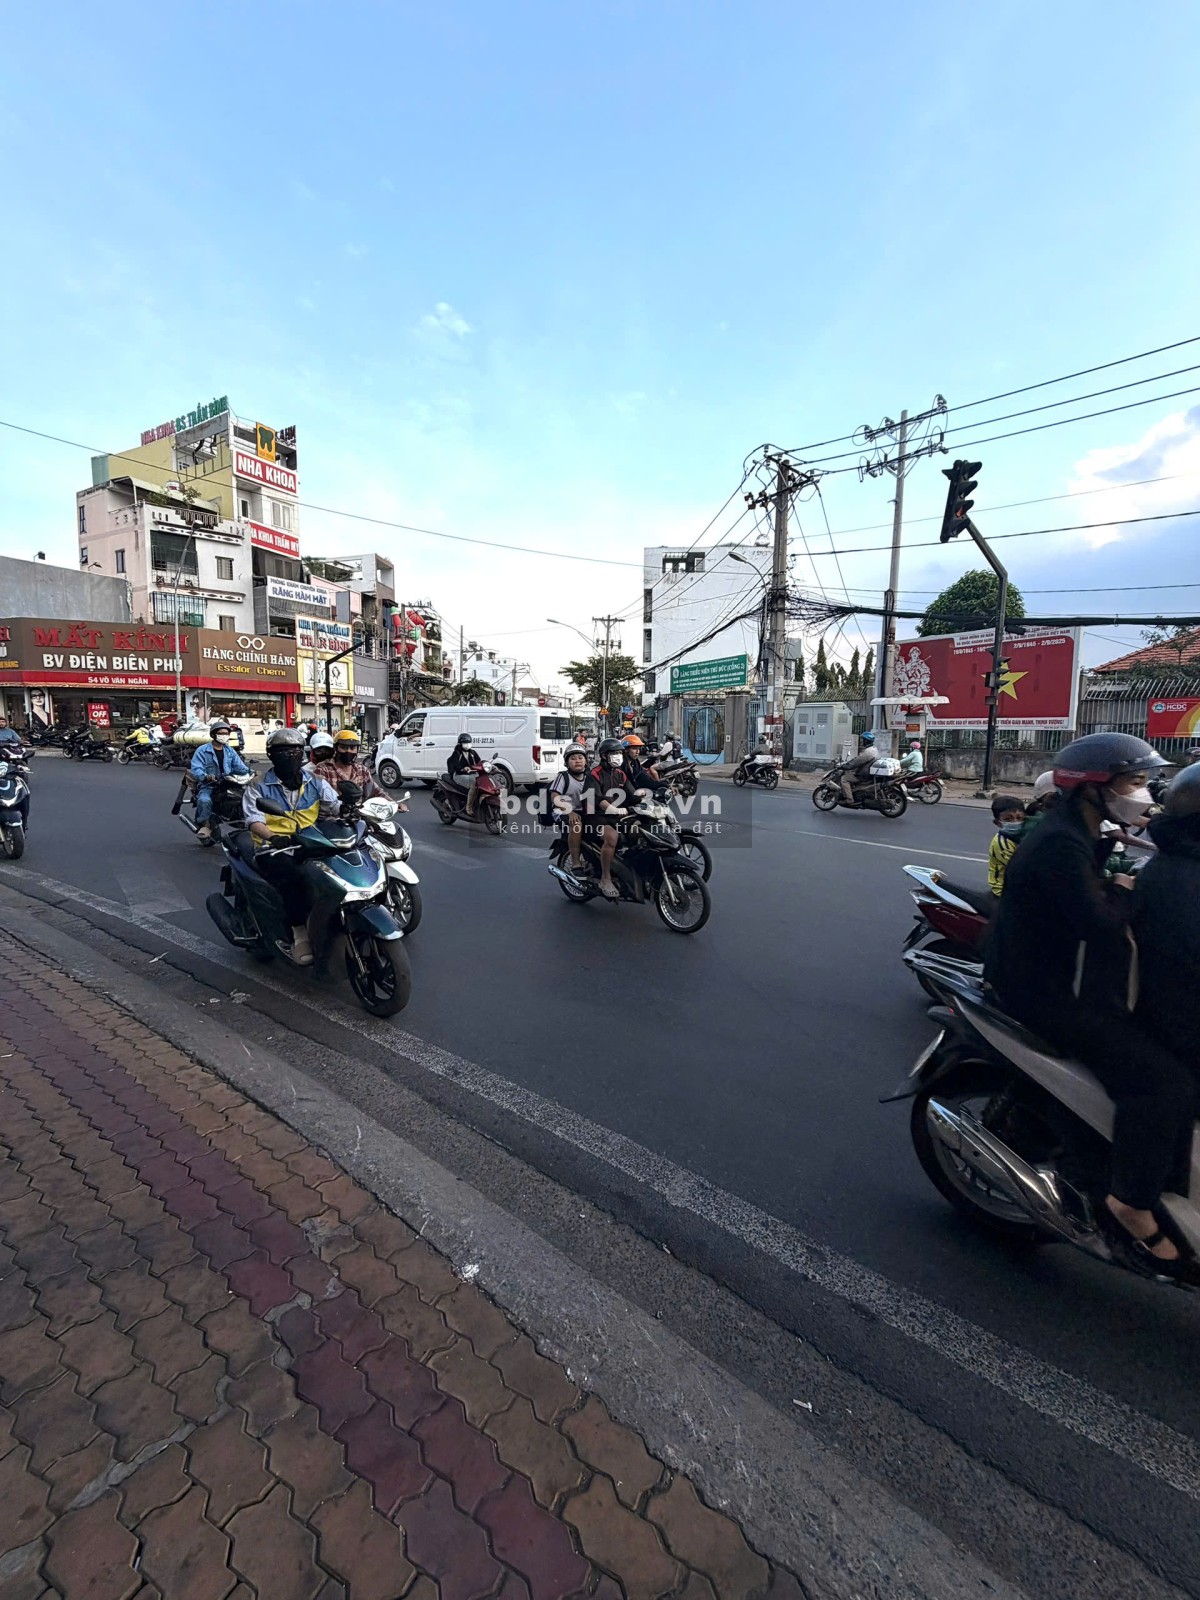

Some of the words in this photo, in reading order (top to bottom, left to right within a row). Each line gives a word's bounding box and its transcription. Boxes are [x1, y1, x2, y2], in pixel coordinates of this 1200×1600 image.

[238, 454, 262, 479] NHA
[266, 467, 295, 491] KHOA
[295, 591, 311, 602] HÀM
[34, 622, 104, 649] MẮT
[112, 626, 190, 654] KÍNH
[43, 654, 64, 668] BV
[69, 652, 108, 672] ĐIỆN
[112, 653, 148, 672] BIÊN
[202, 646, 234, 661] HÀNG
[236, 650, 268, 664] CHÍNH
